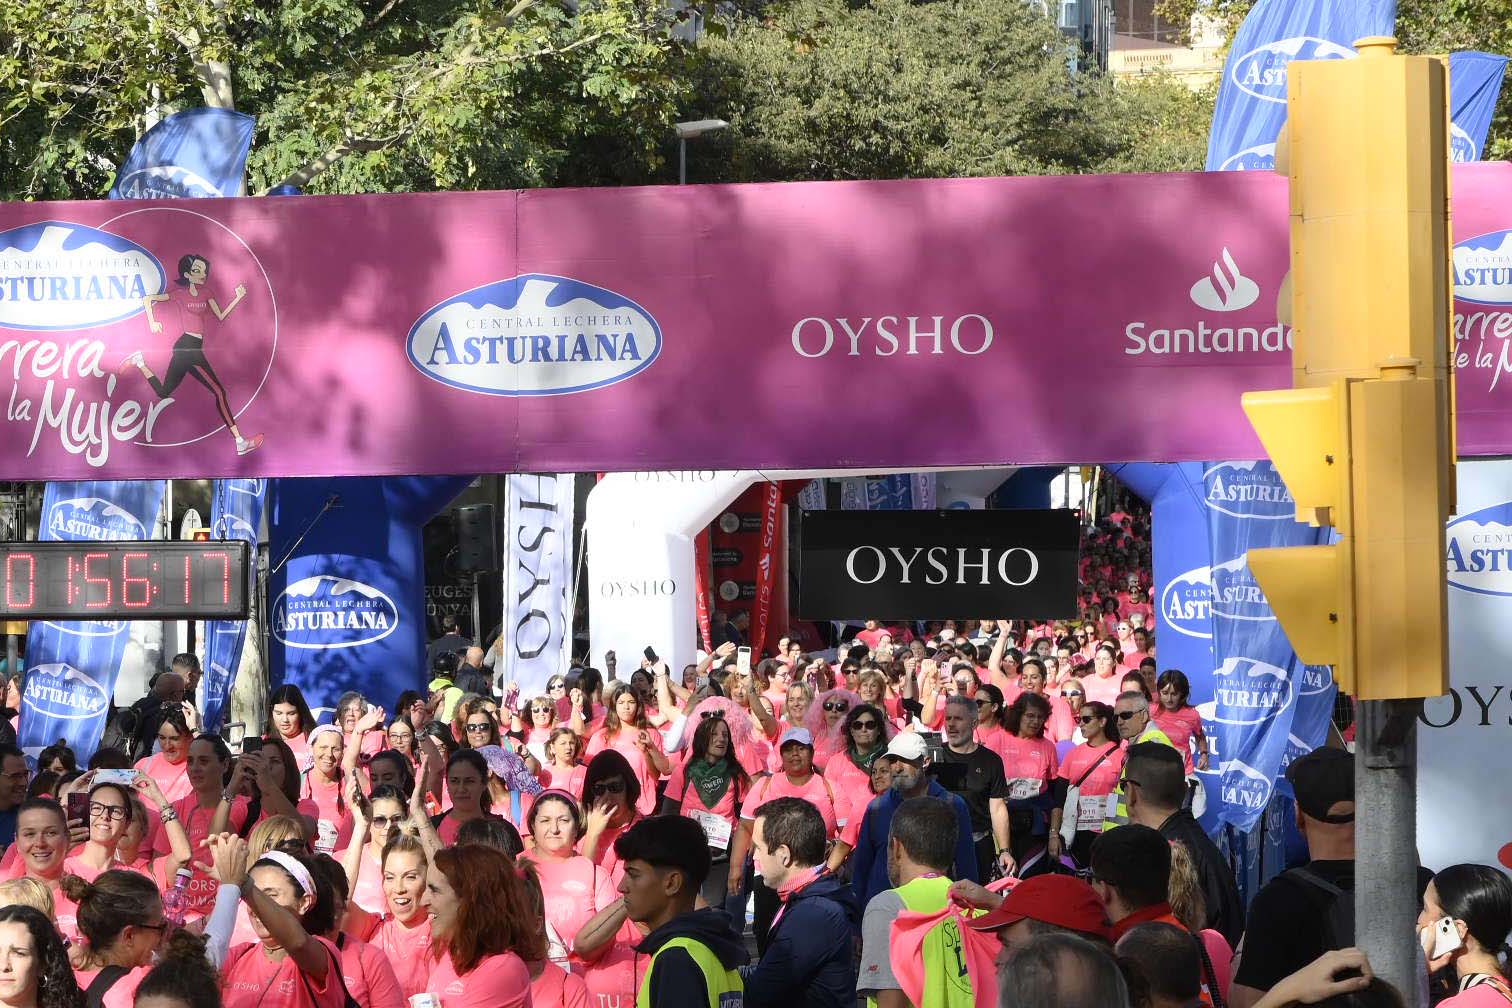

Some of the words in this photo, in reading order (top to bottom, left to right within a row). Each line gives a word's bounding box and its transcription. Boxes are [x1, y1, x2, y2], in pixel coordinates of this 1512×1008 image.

[69, 258, 140, 269] LECHERA
[1466, 256, 1512, 264] CENTRA
[466, 317, 544, 329] CENTRAL
[552, 315, 633, 327] LECHERA
[791, 313, 994, 358] OYSHO
[426, 321, 642, 365] ASTURIANA
[1125, 321, 1294, 355] Santand
[1476, 341, 1493, 369] la
[8, 381, 32, 422] la
[27, 373, 175, 468] Mujer
[1208, 475, 1294, 502] ASTURIA
[516, 474, 558, 660] OYSH
[846, 545, 1039, 586] OYSHO
[277, 606, 388, 632] ASTURIANA
[288, 601, 330, 609] CENTRAL
